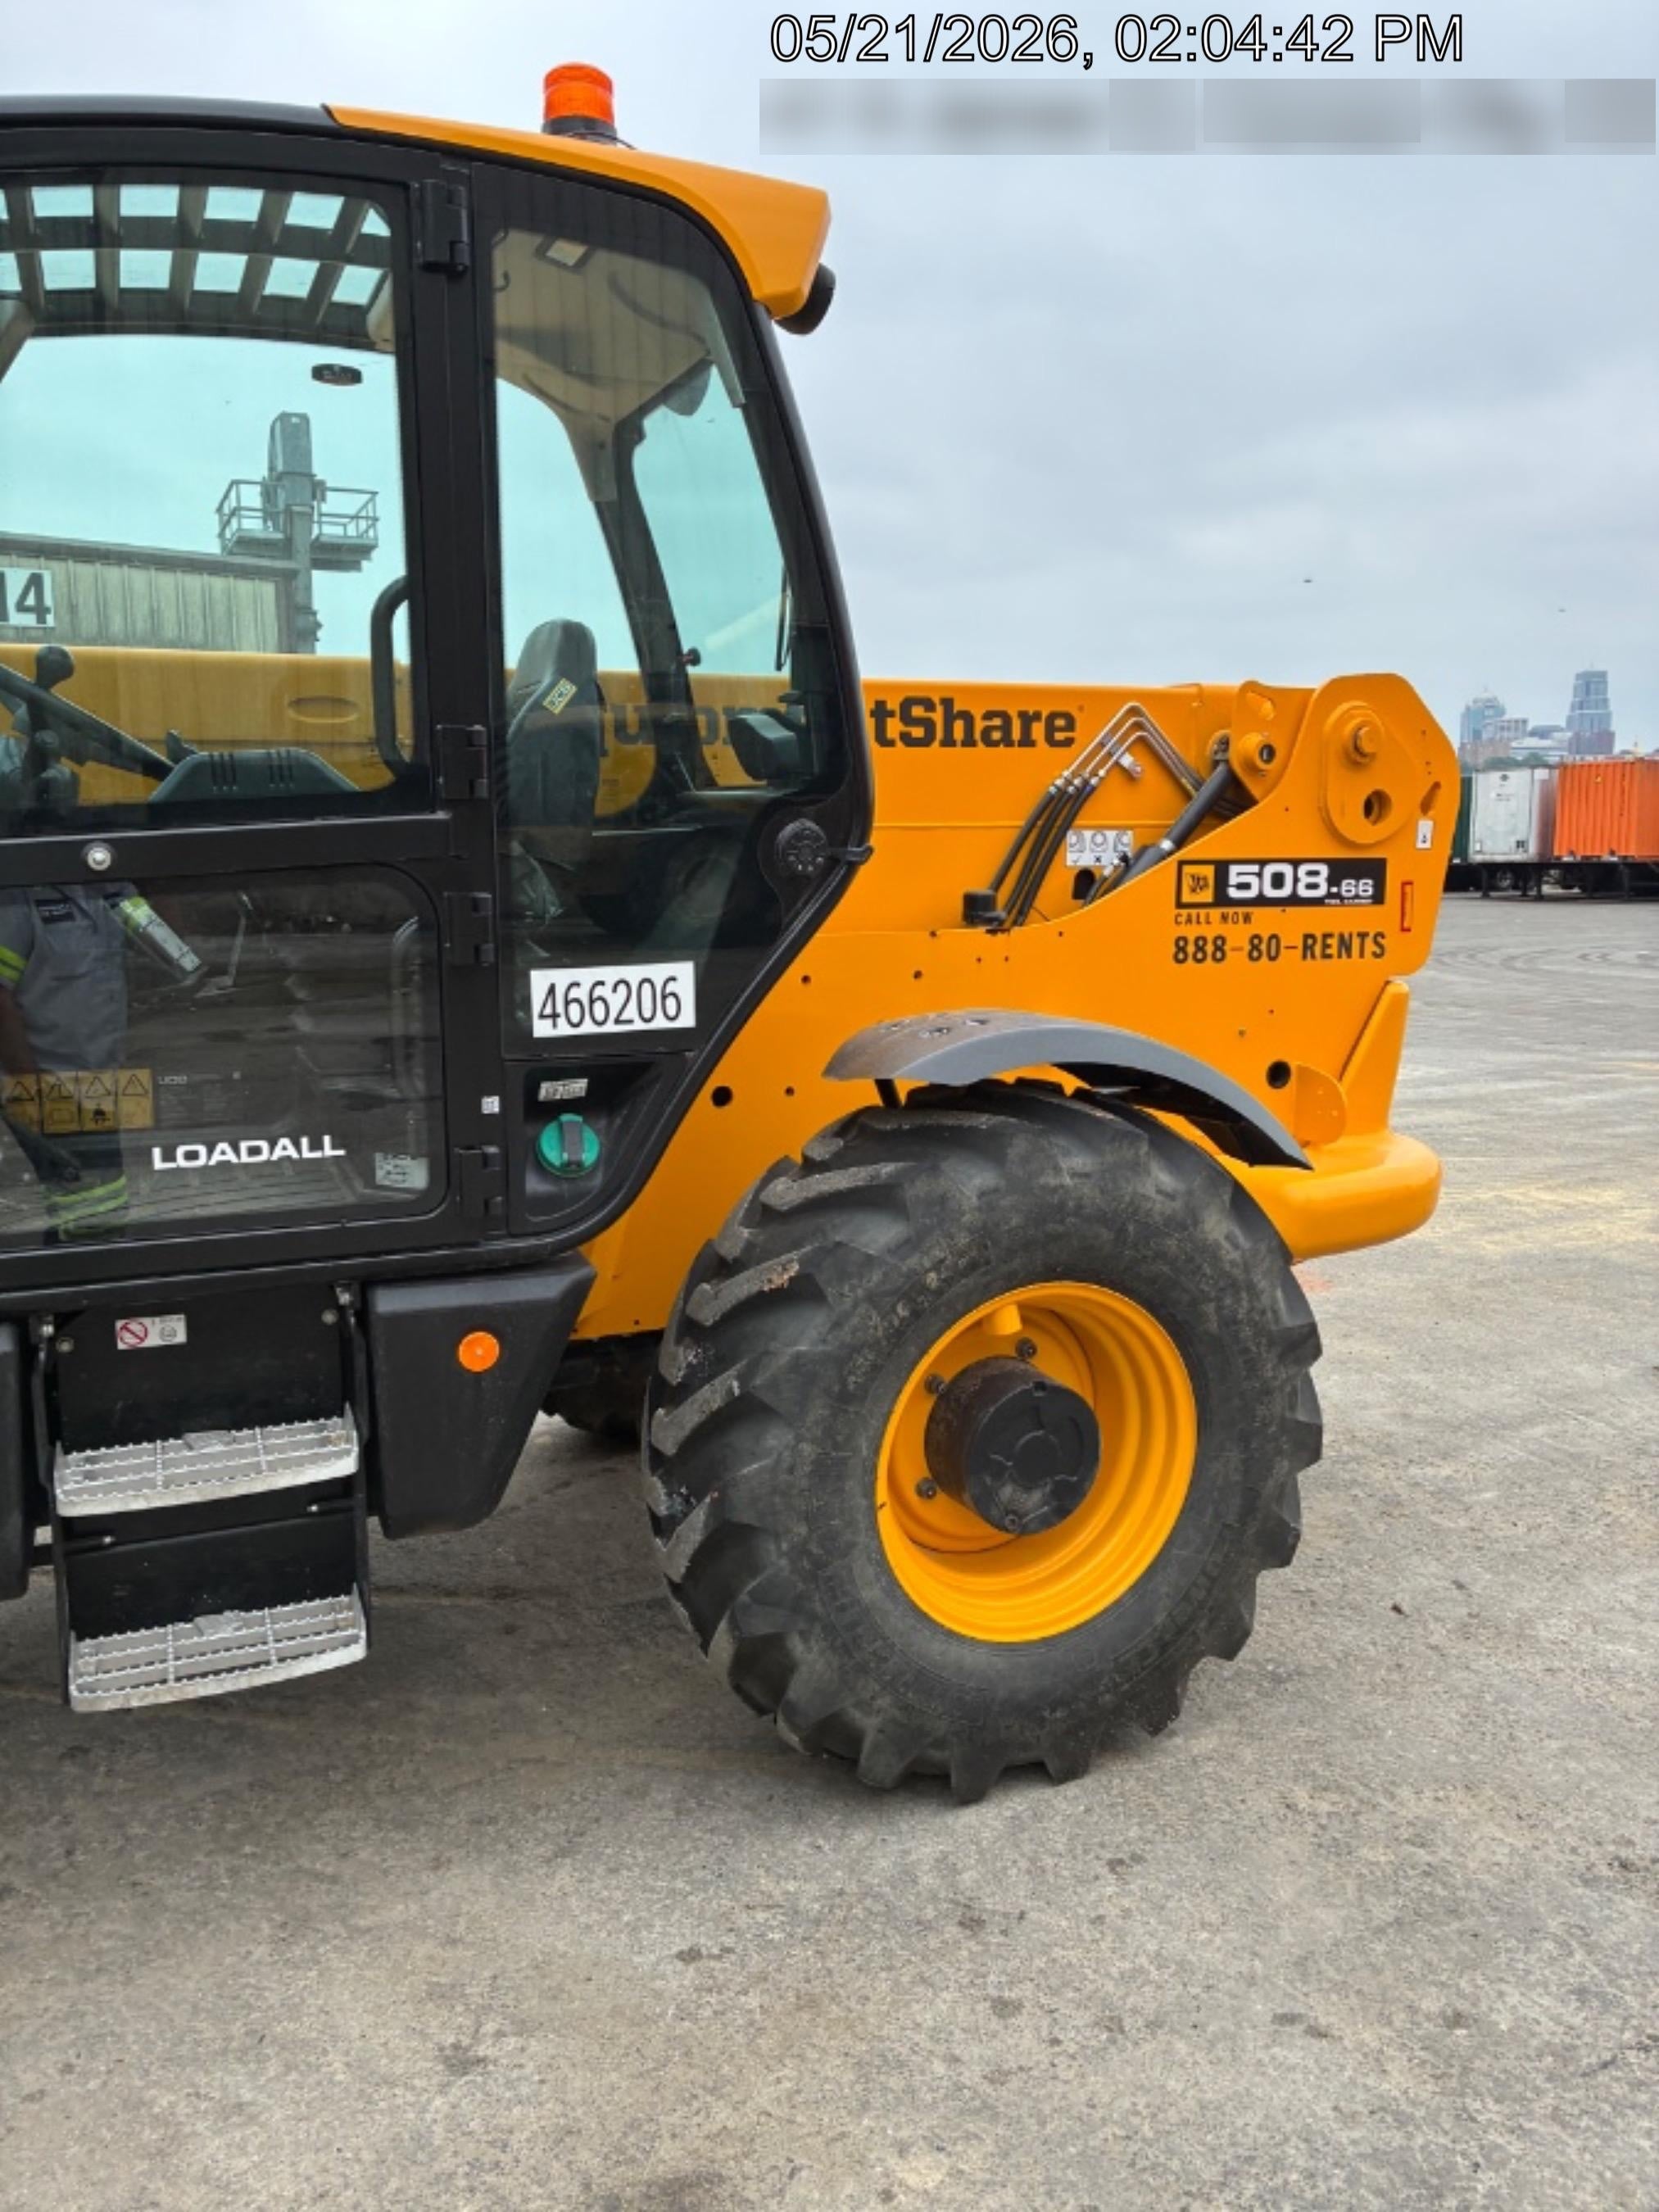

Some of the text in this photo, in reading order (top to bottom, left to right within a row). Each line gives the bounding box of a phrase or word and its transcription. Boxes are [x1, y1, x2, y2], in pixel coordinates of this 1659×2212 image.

[1174, 911, 1253, 926] CALL NOW
[1172, 931, 1387, 964] 888-80-RENTS
[537, 976, 682, 1030] 466206
[152, 1134, 346, 1171] LOADALL
